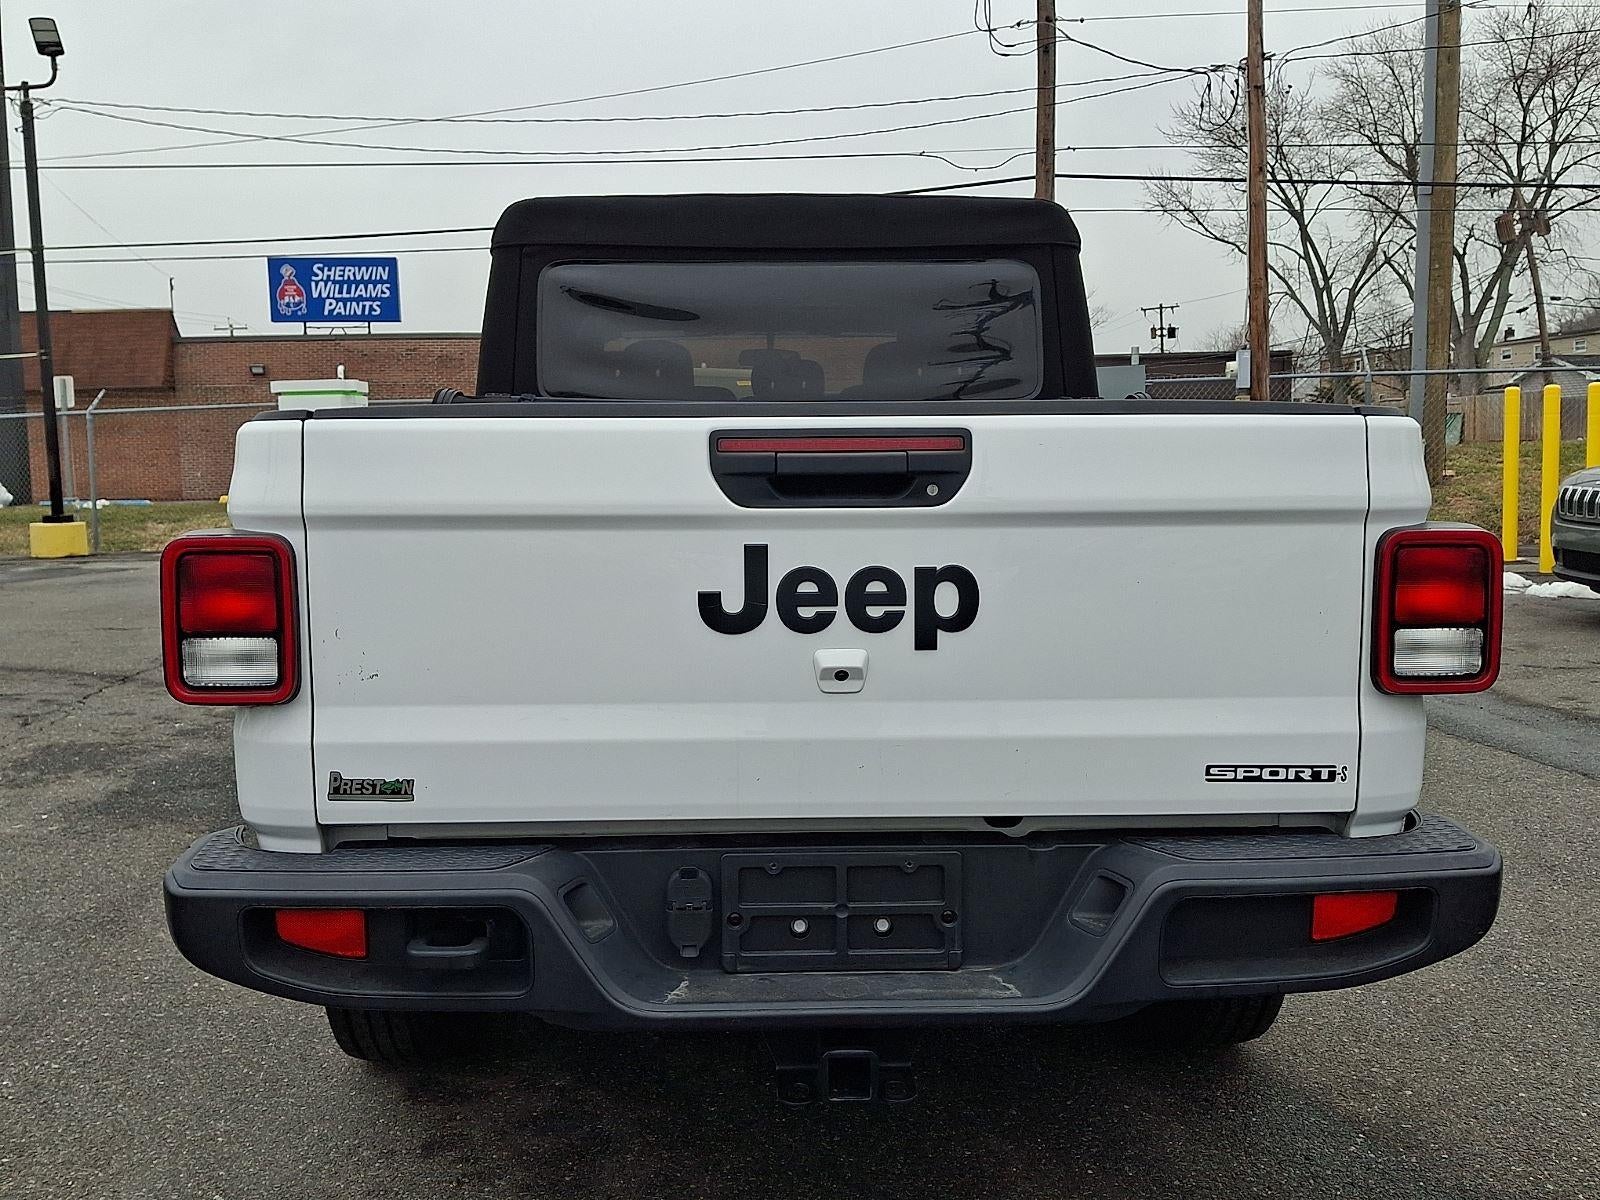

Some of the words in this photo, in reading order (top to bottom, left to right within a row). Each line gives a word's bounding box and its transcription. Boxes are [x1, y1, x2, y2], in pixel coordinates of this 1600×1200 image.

[311, 263, 389, 281] SHERWIN
[311, 281, 391, 298] WILLIAMS
[323, 298, 381, 315] PAINTS
[698, 543, 980, 651] Jeep
[329, 772, 413, 795] PRESTN
